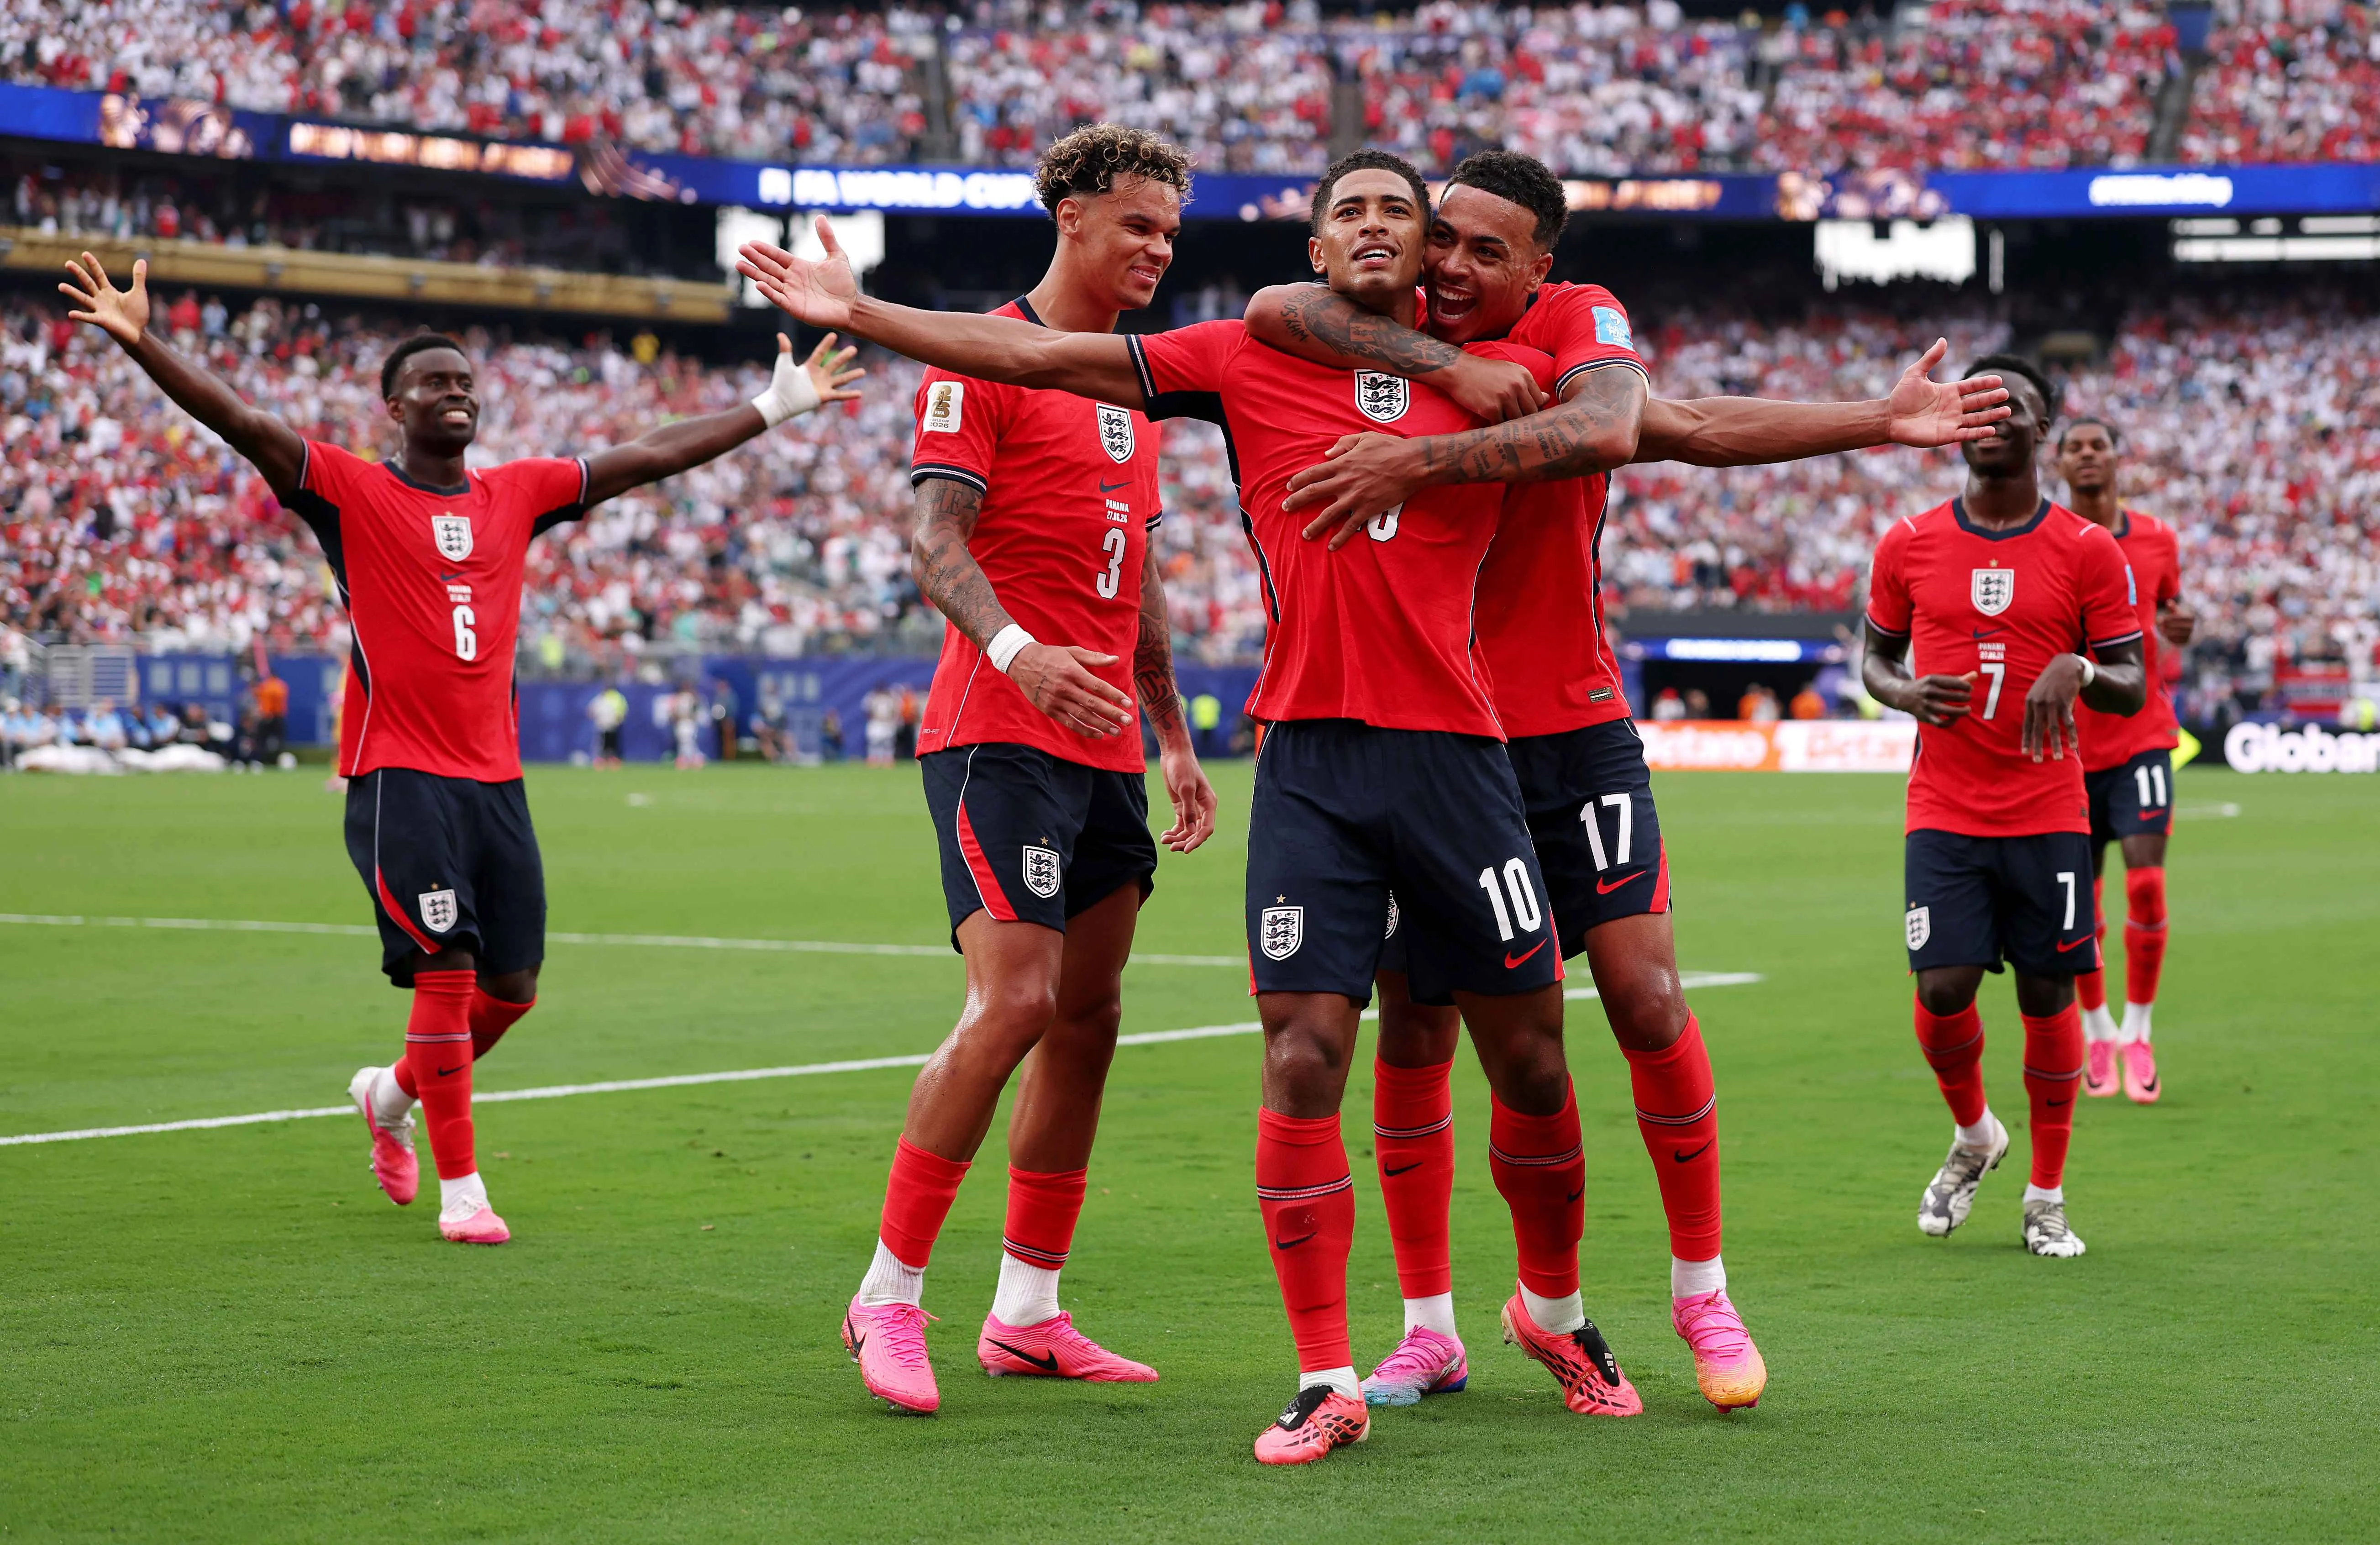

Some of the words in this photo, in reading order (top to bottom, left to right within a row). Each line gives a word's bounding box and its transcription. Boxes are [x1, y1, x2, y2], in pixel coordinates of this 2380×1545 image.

[838, 170, 963, 208] WORLD
[1106, 498, 1129, 513] PANAMA
[1106, 510, 1128, 523] 27.06.26
[1096, 527, 1126, 599] 3
[452, 604, 477, 661] 6
[1980, 663, 2005, 720] 7
[2134, 765, 2167, 807] 11
[1580, 793, 1632, 872] 17
[1478, 857, 1542, 942] 10
[2056, 872, 2075, 930] 7
